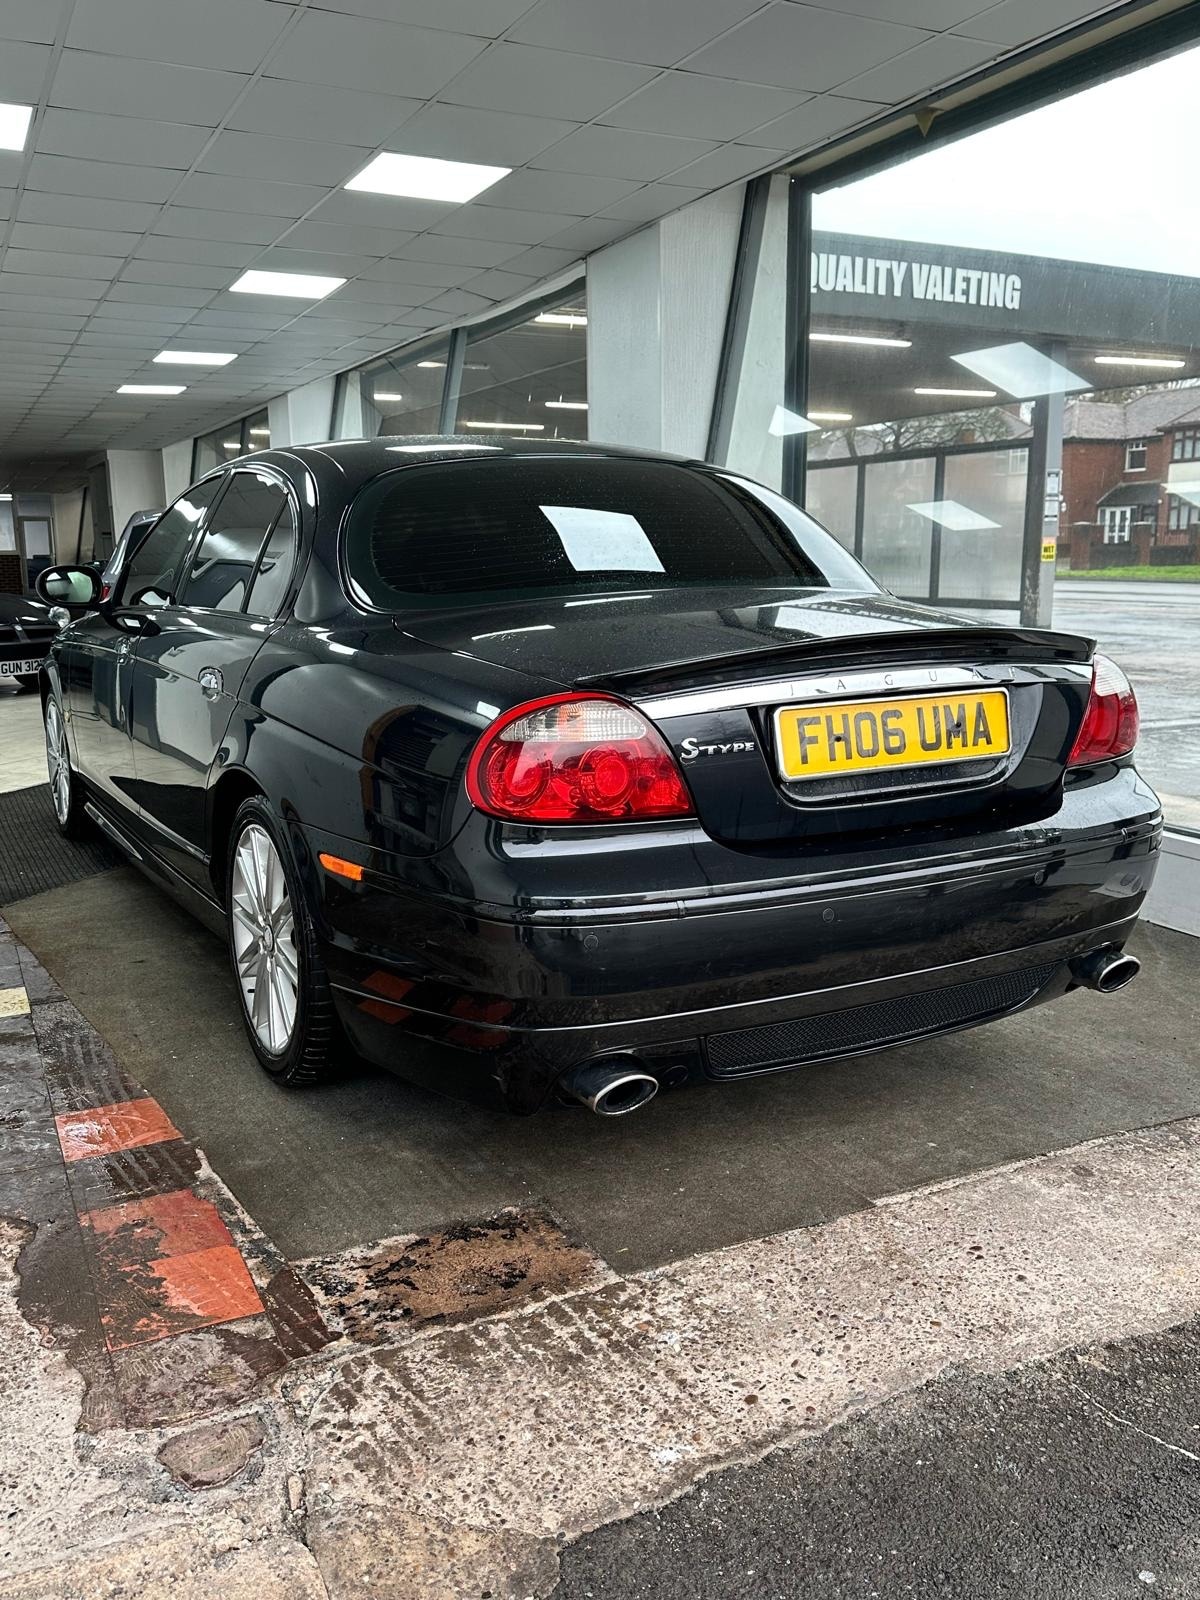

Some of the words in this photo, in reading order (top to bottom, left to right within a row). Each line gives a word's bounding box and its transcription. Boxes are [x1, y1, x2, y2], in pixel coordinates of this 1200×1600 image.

[912, 262, 1022, 310] VALETING
[1, 662, 22, 674] GUN
[796, 709, 906, 765] FH06
[916, 702, 992, 751] UMA
